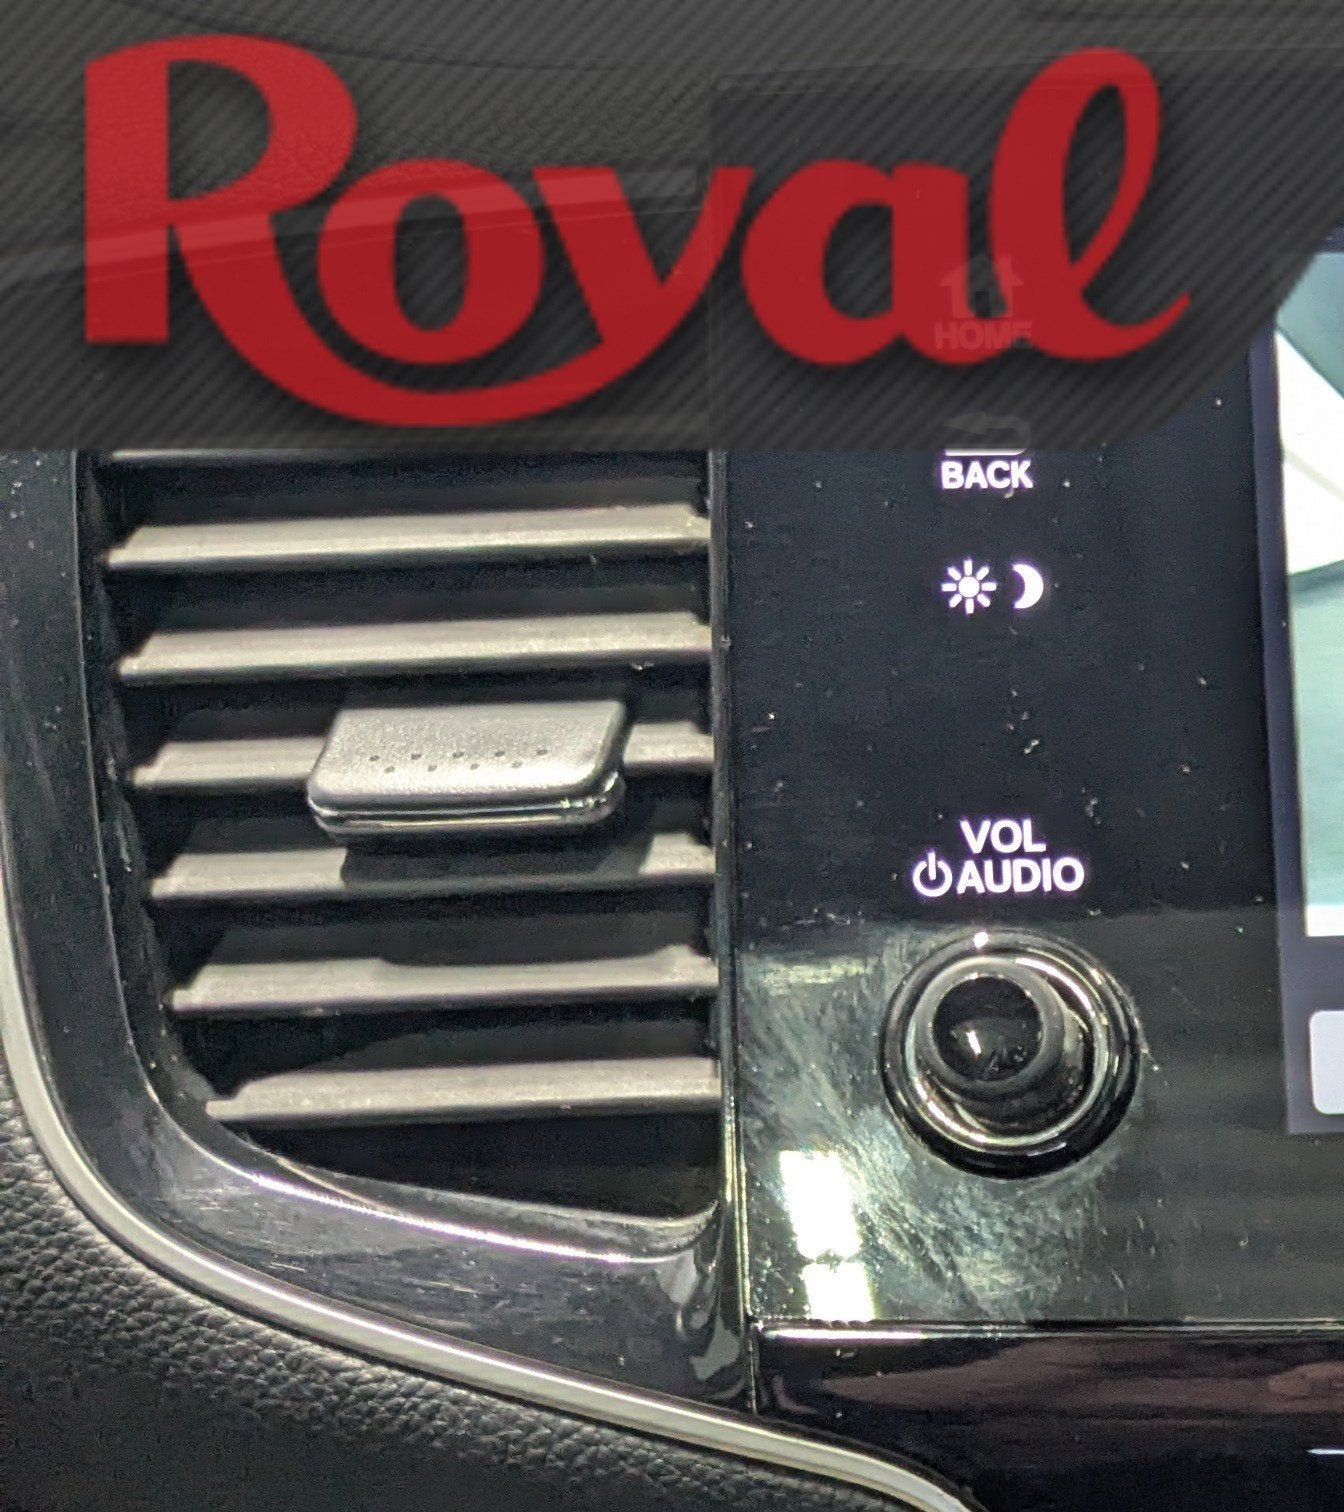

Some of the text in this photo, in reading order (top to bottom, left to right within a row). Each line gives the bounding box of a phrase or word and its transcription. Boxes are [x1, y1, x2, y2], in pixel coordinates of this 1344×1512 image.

[940, 460, 1034, 490] BACK
[960, 818, 1047, 855] VOL
[957, 855, 1086, 896] AUDIO
